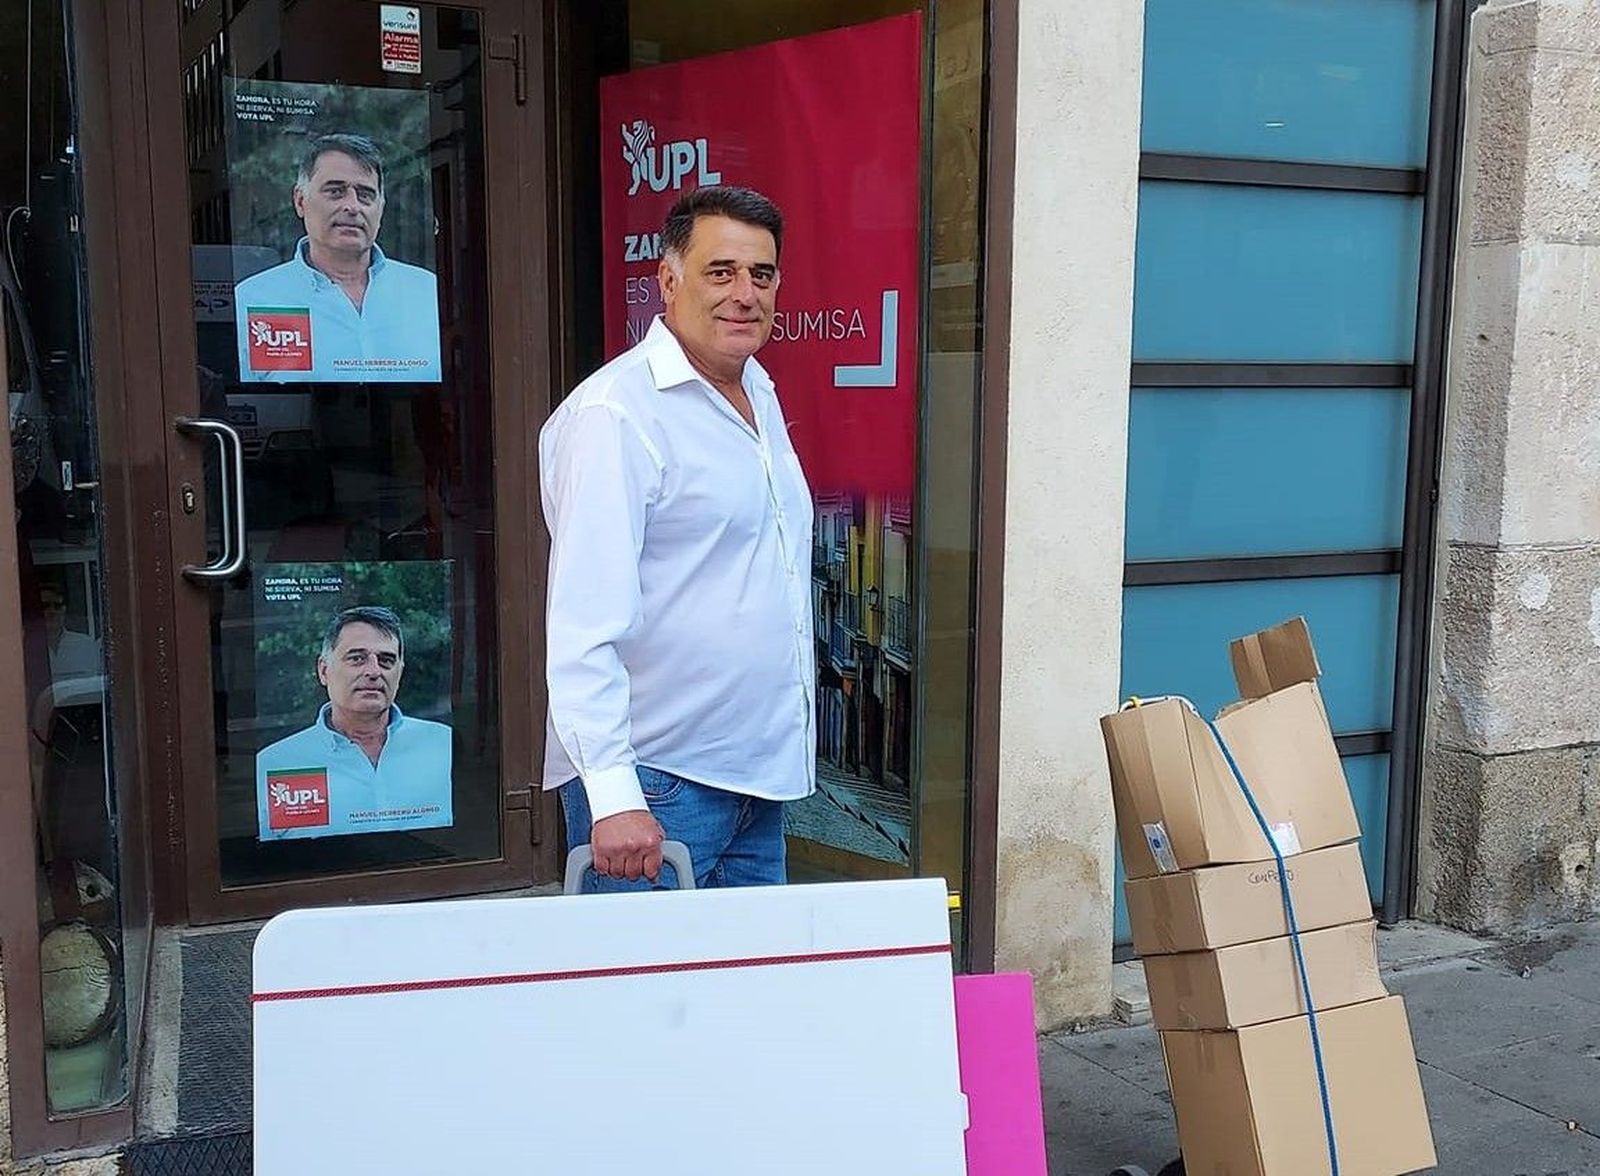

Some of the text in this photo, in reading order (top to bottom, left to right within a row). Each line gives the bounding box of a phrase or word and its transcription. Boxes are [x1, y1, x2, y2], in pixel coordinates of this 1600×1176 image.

[384, 32, 419, 44] Alarma
[271, 97, 281, 105] ES
[282, 98, 293, 106] TU
[236, 112, 258, 120] VOTA
[646, 138, 721, 192] UPL
[625, 277, 650, 304] ES
[771, 308, 866, 341] SUMISA
[267, 330, 308, 347] UPL
[285, 789, 325, 806] UPL
